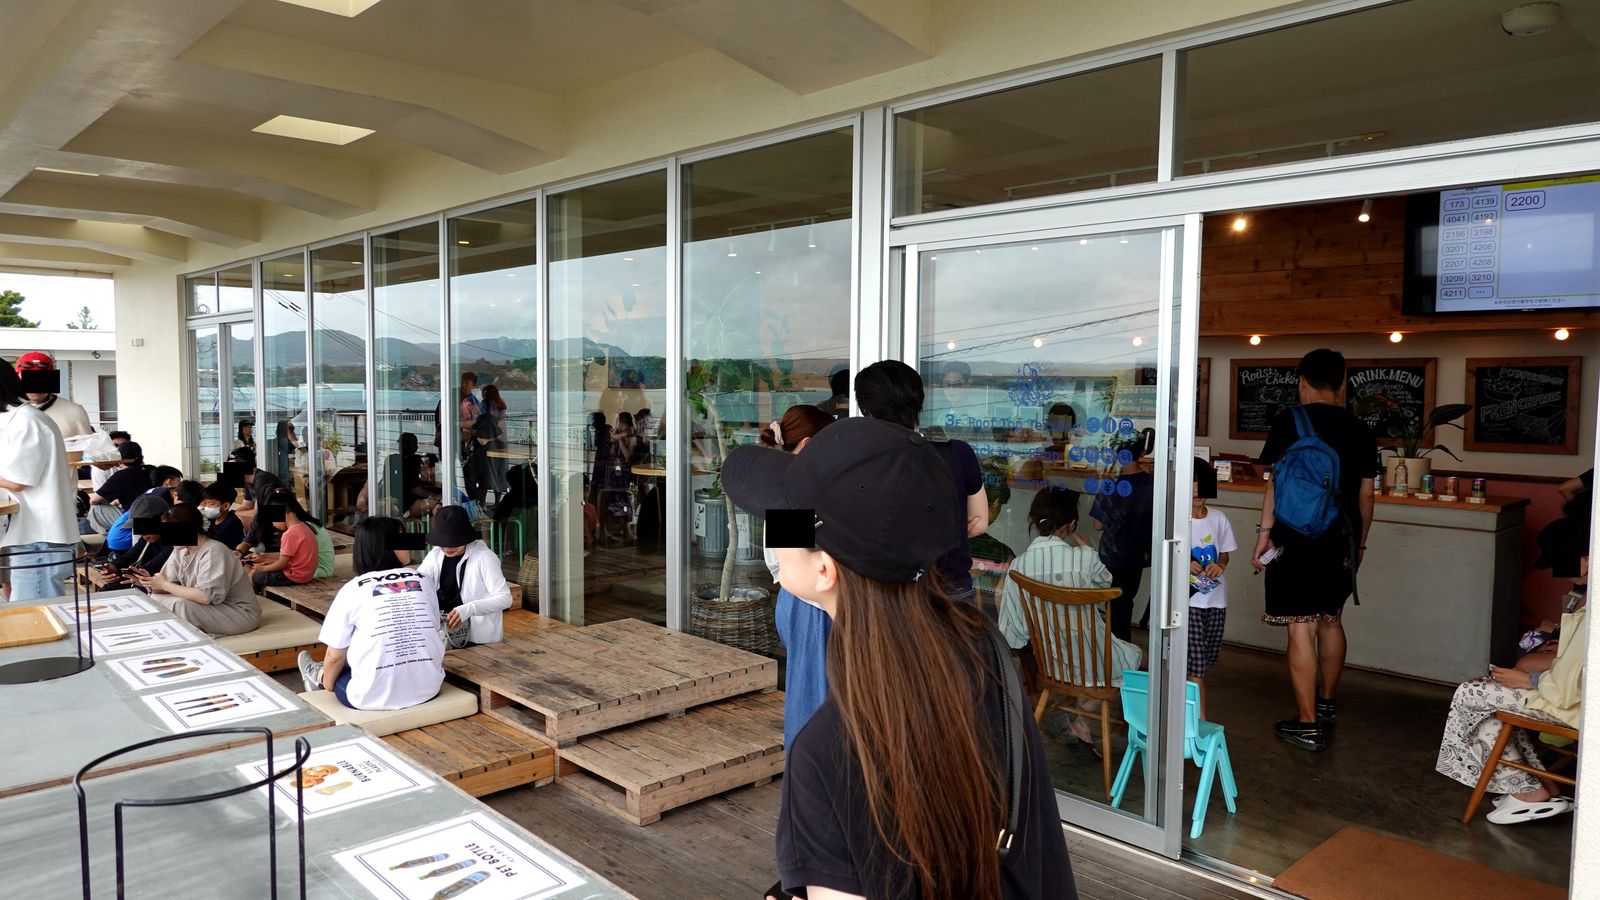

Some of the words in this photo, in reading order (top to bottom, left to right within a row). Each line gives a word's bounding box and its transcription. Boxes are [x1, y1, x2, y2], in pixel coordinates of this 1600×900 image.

[1450, 200, 1464, 208] 173
[1474, 197, 1495, 206] 4139
[1511, 195, 1540, 207] 2200
[1446, 215, 1466, 223] 4041
[1473, 213, 1494, 221] 4192
[1443, 275, 1464, 283] 3209
[1471, 273, 1492, 282] 3210
[1442, 290, 1463, 298] 4211
[1240, 368, 1275, 385] Roast
[1349, 368, 1387, 389] DRINK
[1388, 368, 1425, 388] MENU
[968, 416, 997, 428] Roof
[464, 842, 500, 865] BOTTLE
[495, 864, 518, 877] PET
